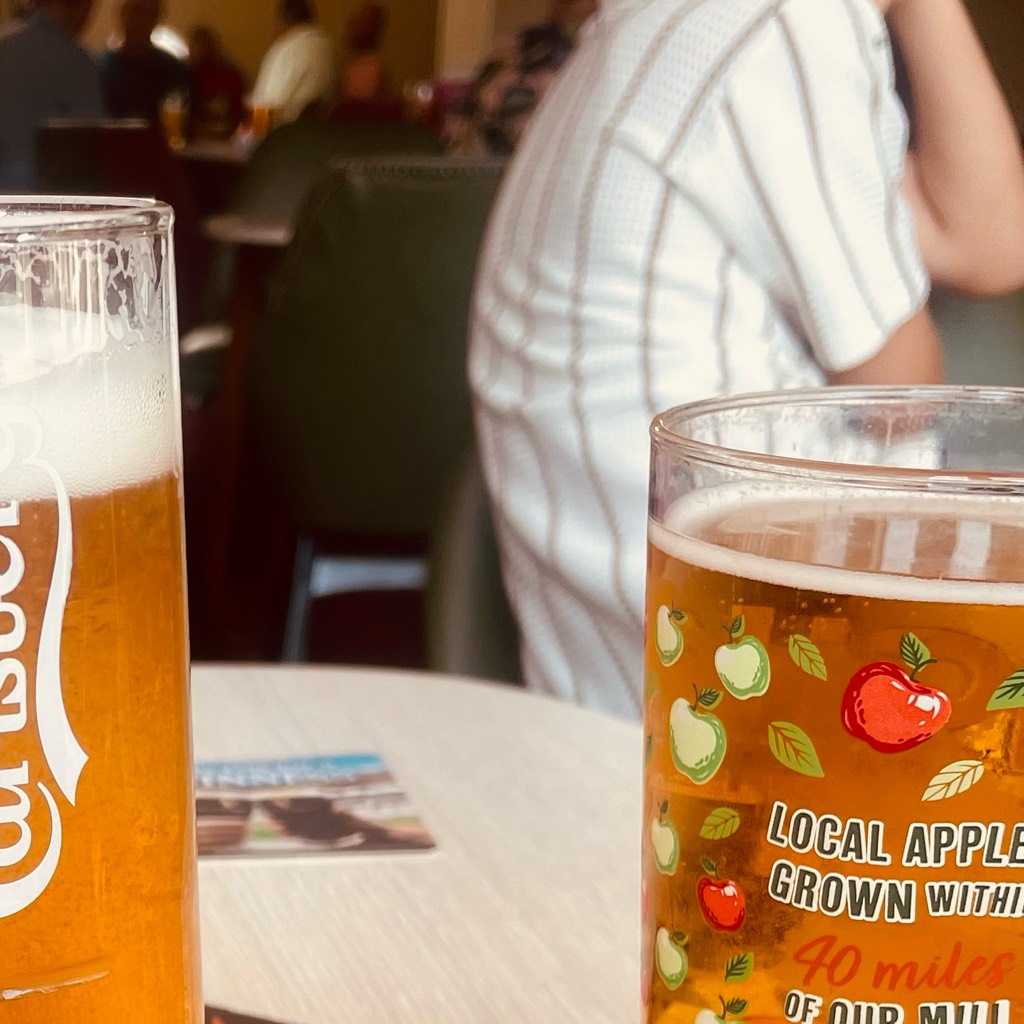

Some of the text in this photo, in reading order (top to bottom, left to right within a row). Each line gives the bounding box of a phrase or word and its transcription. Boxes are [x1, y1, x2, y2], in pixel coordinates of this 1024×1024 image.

[766, 801, 891, 866] LOCAL
[768, 859, 1024, 924] GROWN WITHI
[793, 935, 1016, 992] 40 miles
